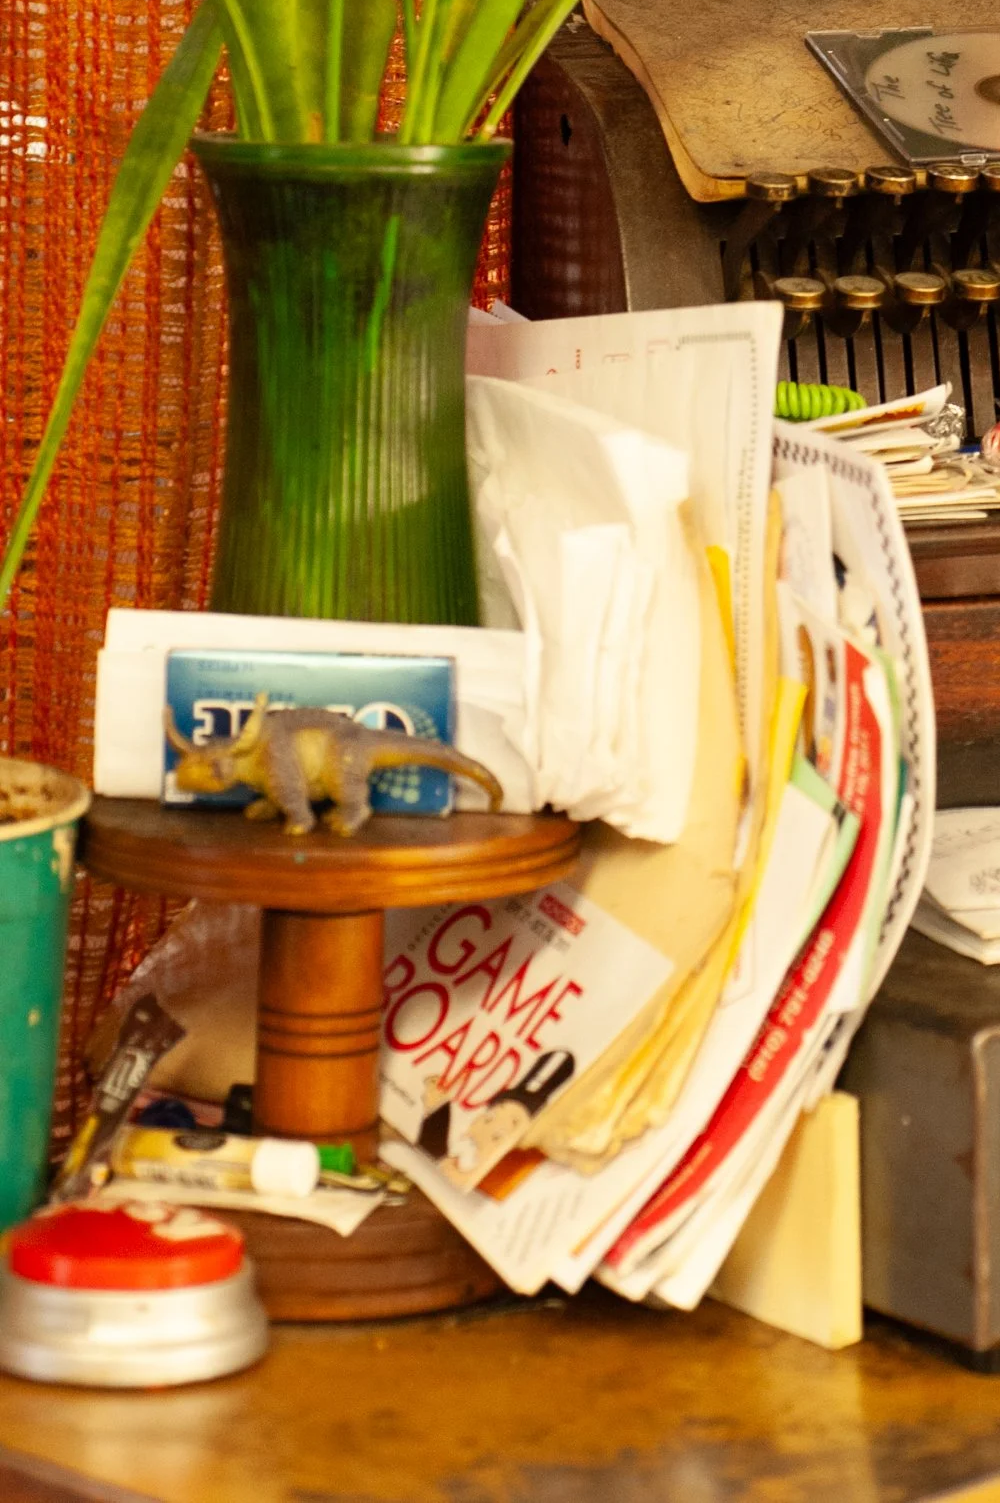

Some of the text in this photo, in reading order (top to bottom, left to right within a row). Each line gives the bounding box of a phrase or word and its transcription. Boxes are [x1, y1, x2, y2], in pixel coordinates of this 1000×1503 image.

[871, 75, 906, 102] The
[926, 80, 954, 99] of
[928, 103, 963, 135] Tree
[427, 904, 584, 1053] GAME
